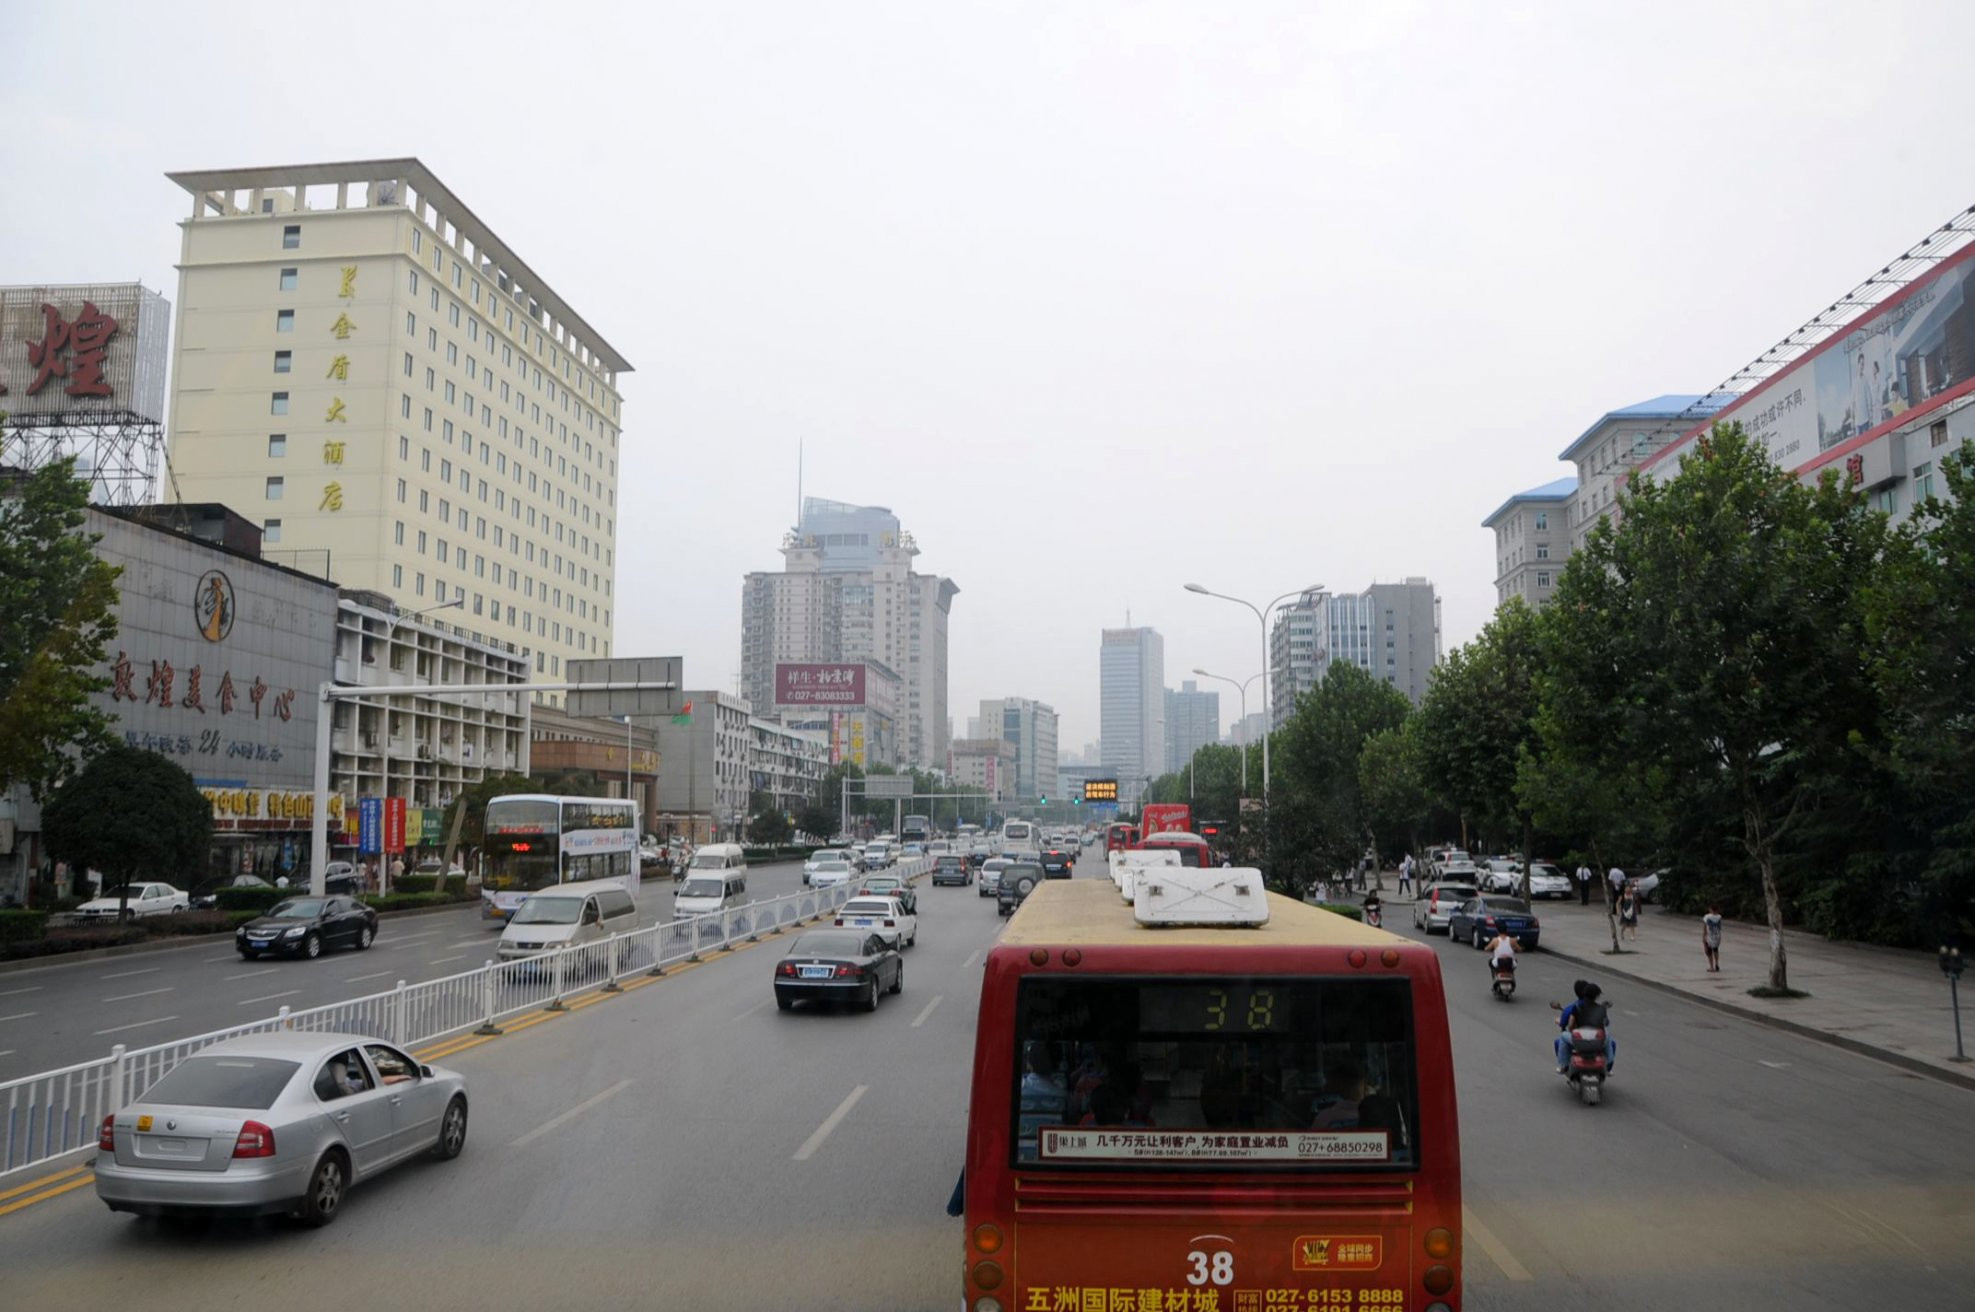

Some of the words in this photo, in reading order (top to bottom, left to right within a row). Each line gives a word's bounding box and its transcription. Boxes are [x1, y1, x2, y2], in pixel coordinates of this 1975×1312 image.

[0, 299, 120, 397] 煌
[110, 650, 296, 722] 敦煌美食中心
[1204, 989, 1274, 1031] 38
[1186, 1251, 1234, 1286] 38
[1025, 1286, 1220, 1312] 五洲国际建材城
[1265, 1288, 1353, 1304] 027-6153
[1358, 1288, 1404, 1304] 8888
